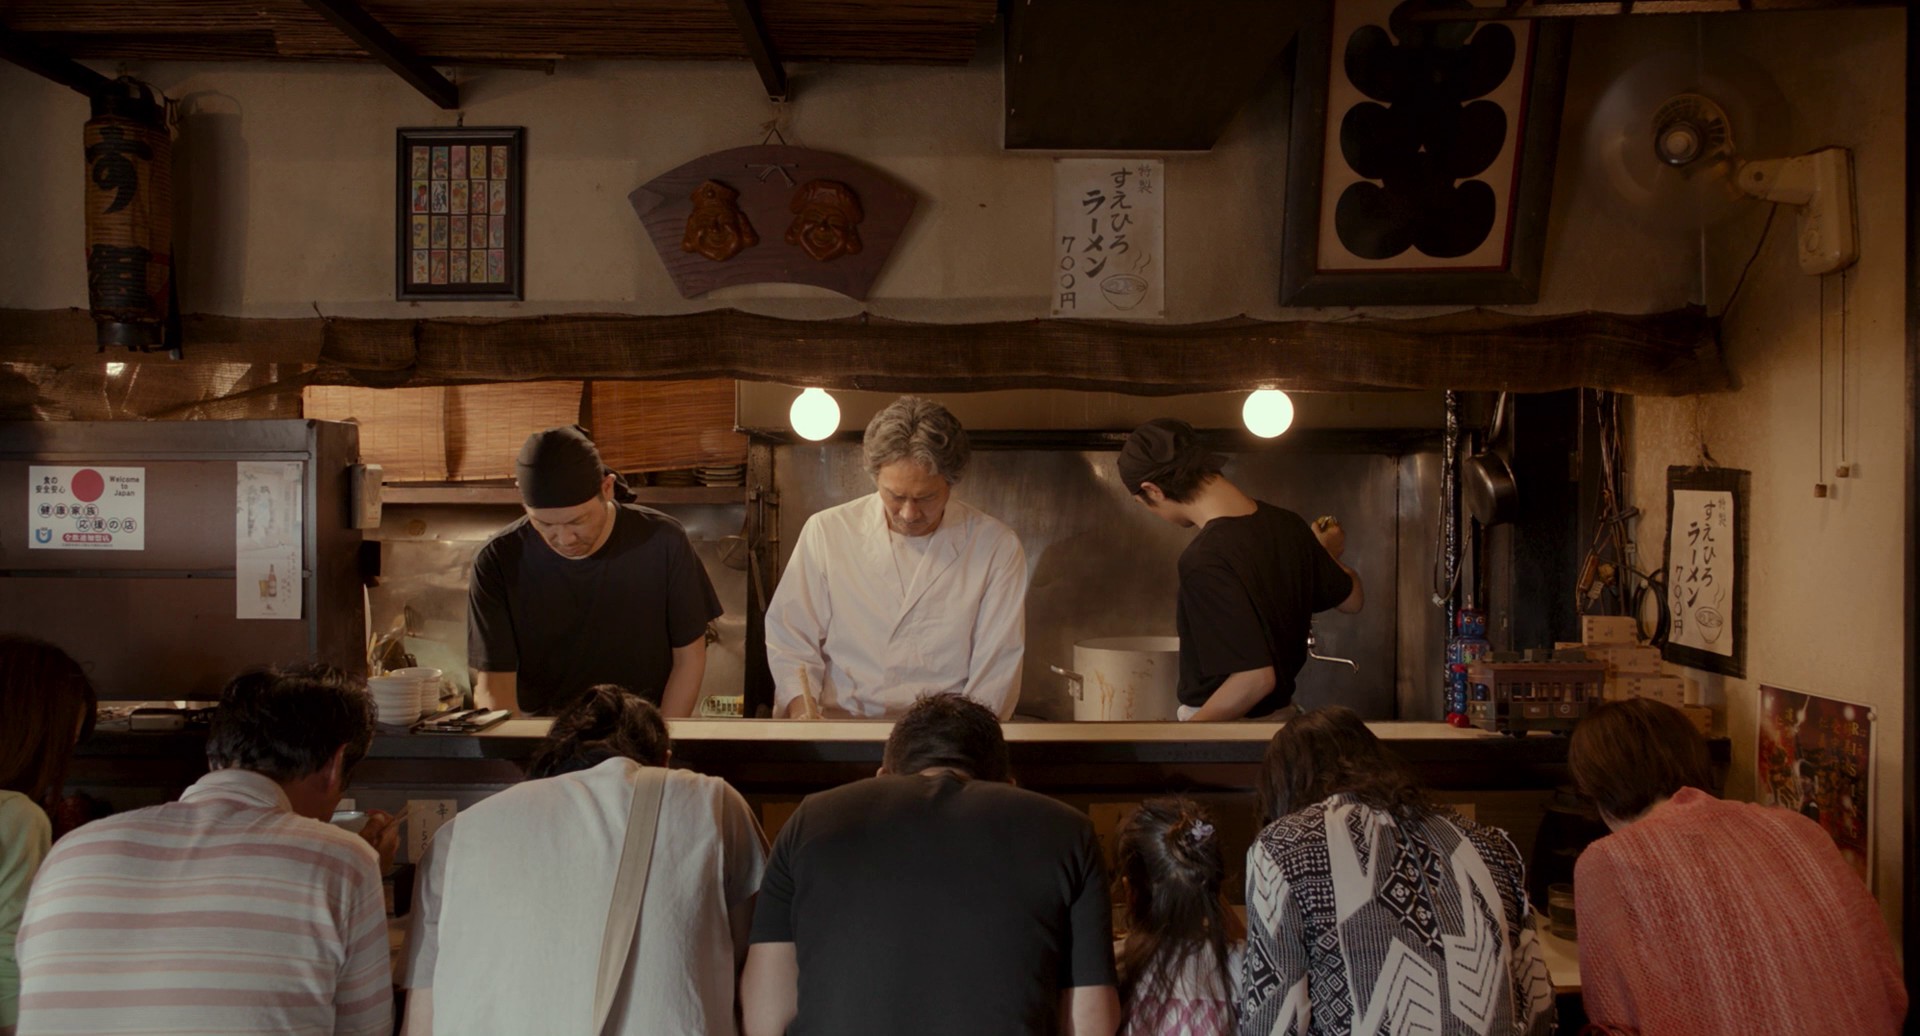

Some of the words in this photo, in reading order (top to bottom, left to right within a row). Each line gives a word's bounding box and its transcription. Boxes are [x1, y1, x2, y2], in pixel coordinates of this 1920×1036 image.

[1137, 163, 1153, 194] 特製
[1110, 167, 1133, 255] すえひろ
[1082, 189, 1108, 279] ラーメン
[109, 476, 140, 484] Welcome
[114, 489, 135, 497] Japan
[39, 503, 98, 518] 健康家族
[77, 518, 136, 532] 応援の店
[1701, 500, 1716, 587] すえひろ
[1686, 521, 1700, 608] ラーメン
